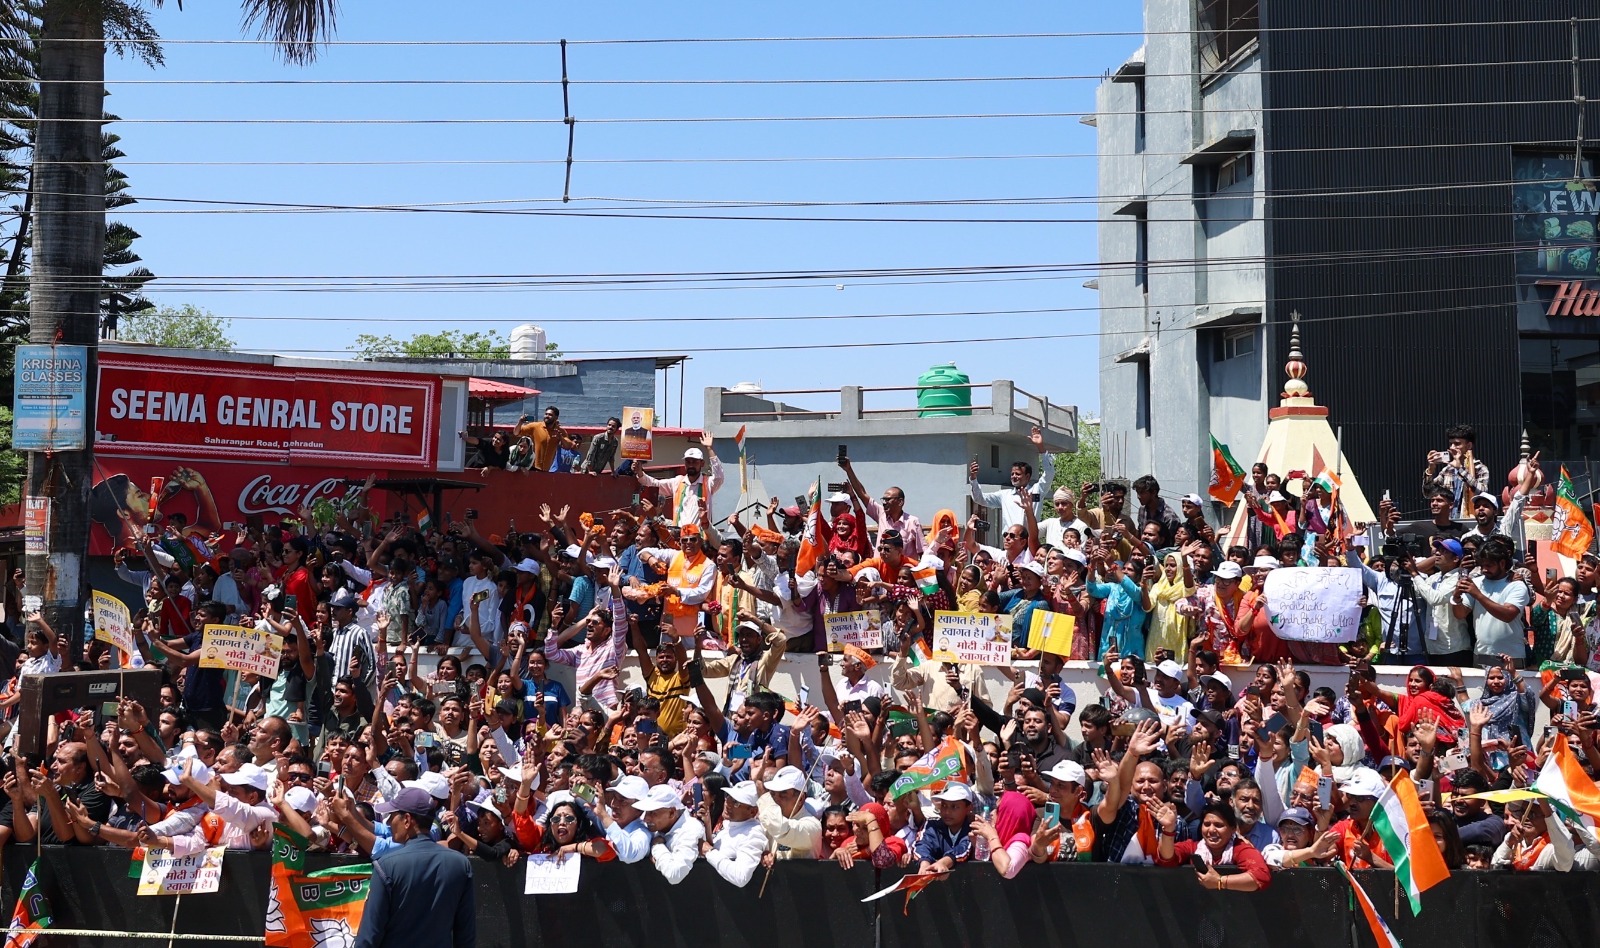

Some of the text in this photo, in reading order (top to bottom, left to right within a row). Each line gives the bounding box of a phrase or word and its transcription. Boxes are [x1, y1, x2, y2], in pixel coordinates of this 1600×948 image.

[21, 358, 82, 370] KRISHNA
[20, 370, 83, 383] CLASSES
[110, 388, 413, 435] SEEMA GENRAL STORE
[204, 436, 324, 449] Saharanpur Road, Dehradun
[937, 615, 989, 626] स्वागत है जी
[208, 629, 260, 641] स्वागत है जी
[942, 627, 984, 638] स्वागत है।
[211, 638, 255, 650] स्वागत है।
[957, 640, 1007, 652] मोदी जी का
[225, 650, 276, 667] मोदी जी का
[959, 653, 990, 661] स्वागत
[993, 653, 1004, 663] है।
[227, 660, 258, 671] स्वागत
[152, 855, 195, 868] स्वागत है।
[166, 870, 187, 880] मोदी
[189, 869, 201, 879] जी
[166, 882, 198, 891] स्वागत
